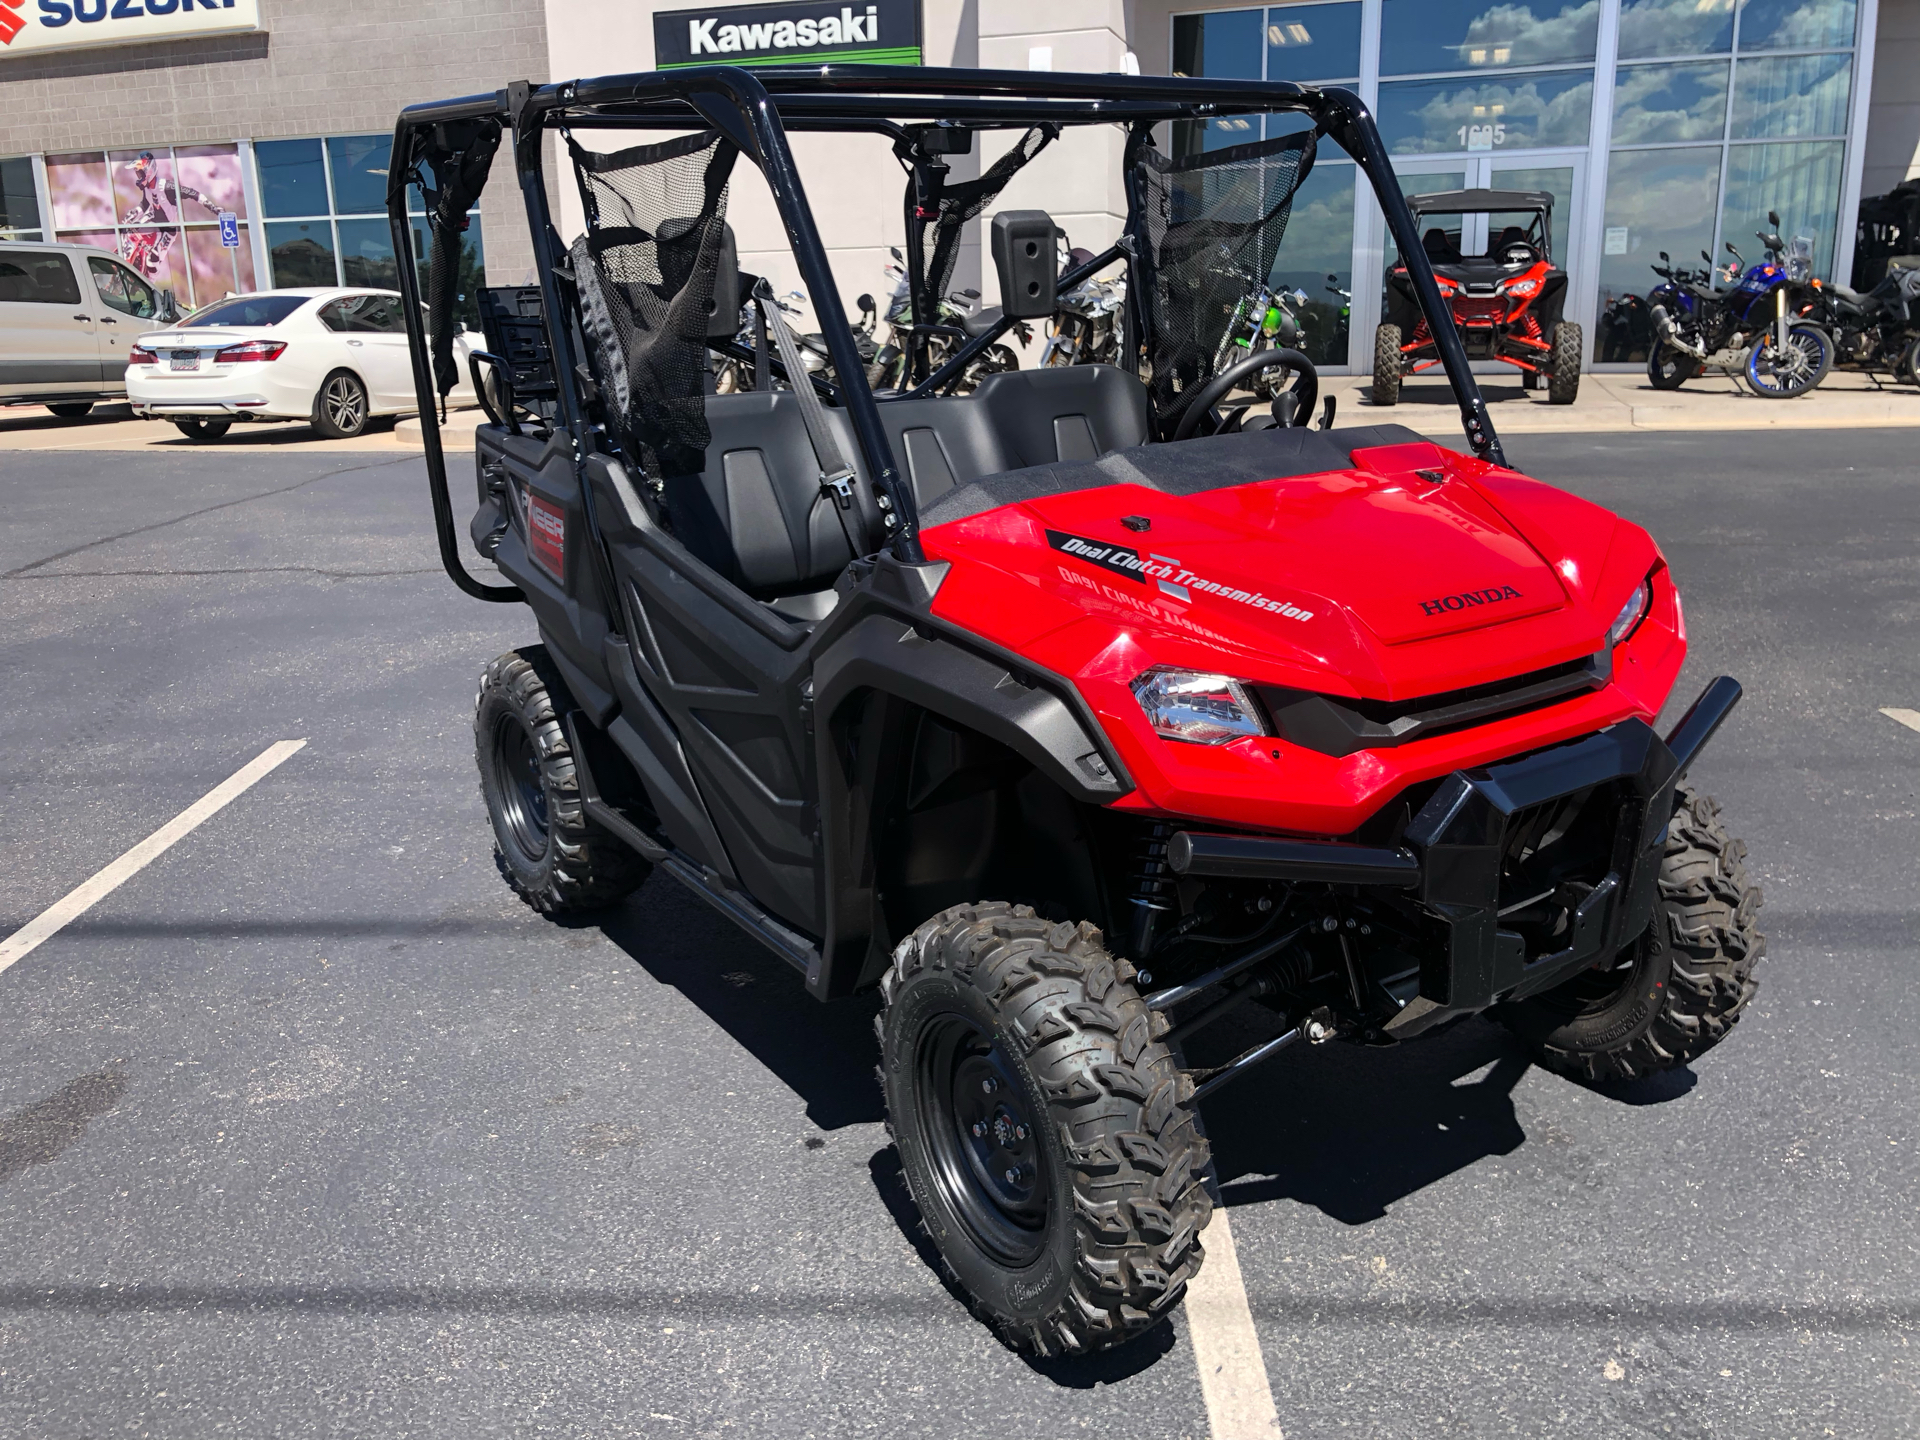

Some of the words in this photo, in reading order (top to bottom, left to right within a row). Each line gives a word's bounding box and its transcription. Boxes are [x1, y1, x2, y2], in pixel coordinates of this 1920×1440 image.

[689, 5, 878, 55] Kawasaki
[1060, 538, 1113, 561] Dual
[1107, 551, 1173, 580] Clutch
[1172, 568, 1315, 623] Transmission
[1418, 584, 1524, 617] HONDA
